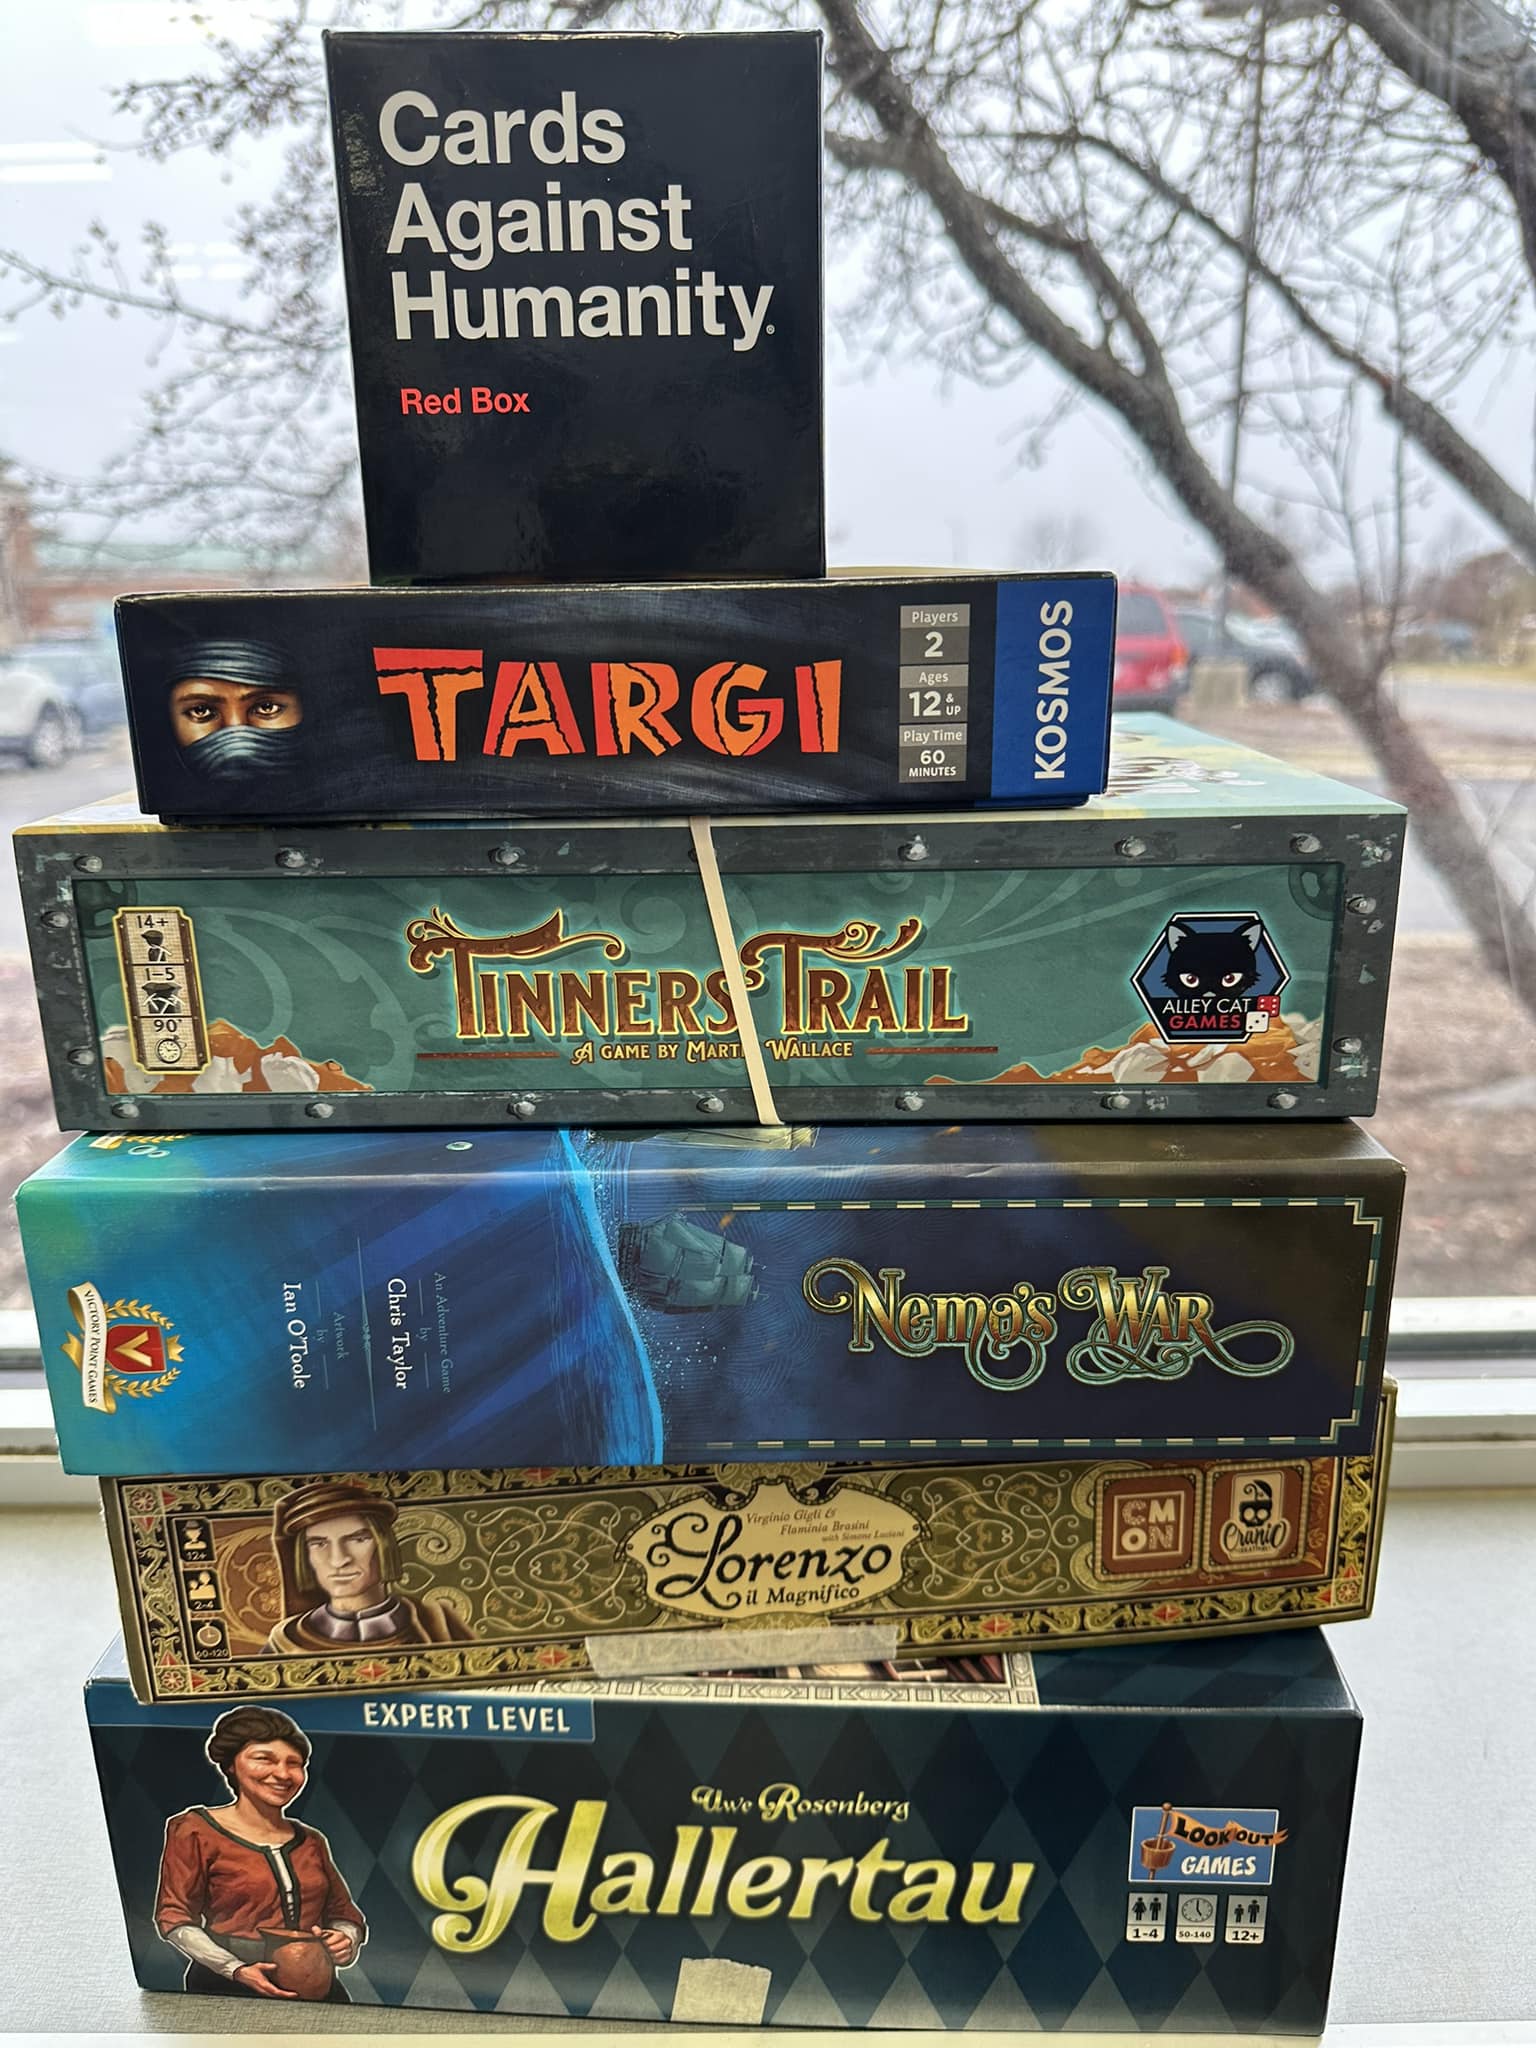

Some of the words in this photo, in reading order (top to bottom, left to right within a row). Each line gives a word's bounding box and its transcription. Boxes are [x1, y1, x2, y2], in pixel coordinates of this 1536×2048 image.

[379, 90, 626, 166] Cards
[387, 181, 693, 271] Against
[401, 387, 462, 415] Red
[472, 387, 530, 414] Box
[912, 611, 959, 624] Players
[925, 631, 943, 657] 2
[919, 672, 949, 685] Ages
[1034, 600, 1073, 779] KOSMOS
[373, 647, 842, 761] TARGI
[909, 691, 941, 716] 12
[946, 705, 961, 716] UP
[903, 731, 930, 743] Play
[932, 729, 963, 741] Time
[909, 767, 957, 777] MINUTES
[920, 750, 945, 765] 60
[137, 915, 168, 928] 14+
[145, 967, 175, 981] 1-5
[739, 917, 969, 1036] TRAIL
[1162, 999, 1212, 1014] ALLEY
[1216, 998, 1252, 1013] CAT
[1169, 1015, 1241, 1029] GAMES
[571, 1040, 595, 1065] A
[601, 1044, 650, 1060] GAME
[657, 1044, 679, 1059] BY
[765, 1038, 853, 1061] WALLACE
[84, 1290, 101, 1335] VICTORY
[282, 1282, 303, 1313] Ian
[387, 1278, 408, 1327] Chris
[333, 1312, 350, 1360] Artwork
[415, 1327, 432, 1341] by
[436, 1295, 450, 1355] Adventure
[88, 1337, 101, 1368] POINT
[287, 1319, 312, 1390] O'Toole
[386, 1331, 413, 1390] Taylor
[87, 1370, 98, 1403] GAMES
[440, 1359, 454, 1393] Game
[746, 1511, 790, 1525] Virginio
[646, 1511, 892, 1610] Lorenzo
[746, 1589, 758, 1605] il
[766, 1584, 860, 1606] Magnifico
[363, 1702, 472, 1730] EXPERT
[486, 1706, 571, 1733] LEVEL
[691, 1785, 752, 1814] Uwe
[758, 1782, 911, 1822] Rosenberg
[412, 1794, 1035, 1953] Hallertau
[1181, 1855, 1257, 1876] GAMES
[1132, 1928, 1159, 1939] 1-4
[1232, 1930, 1259, 1941] 12+
